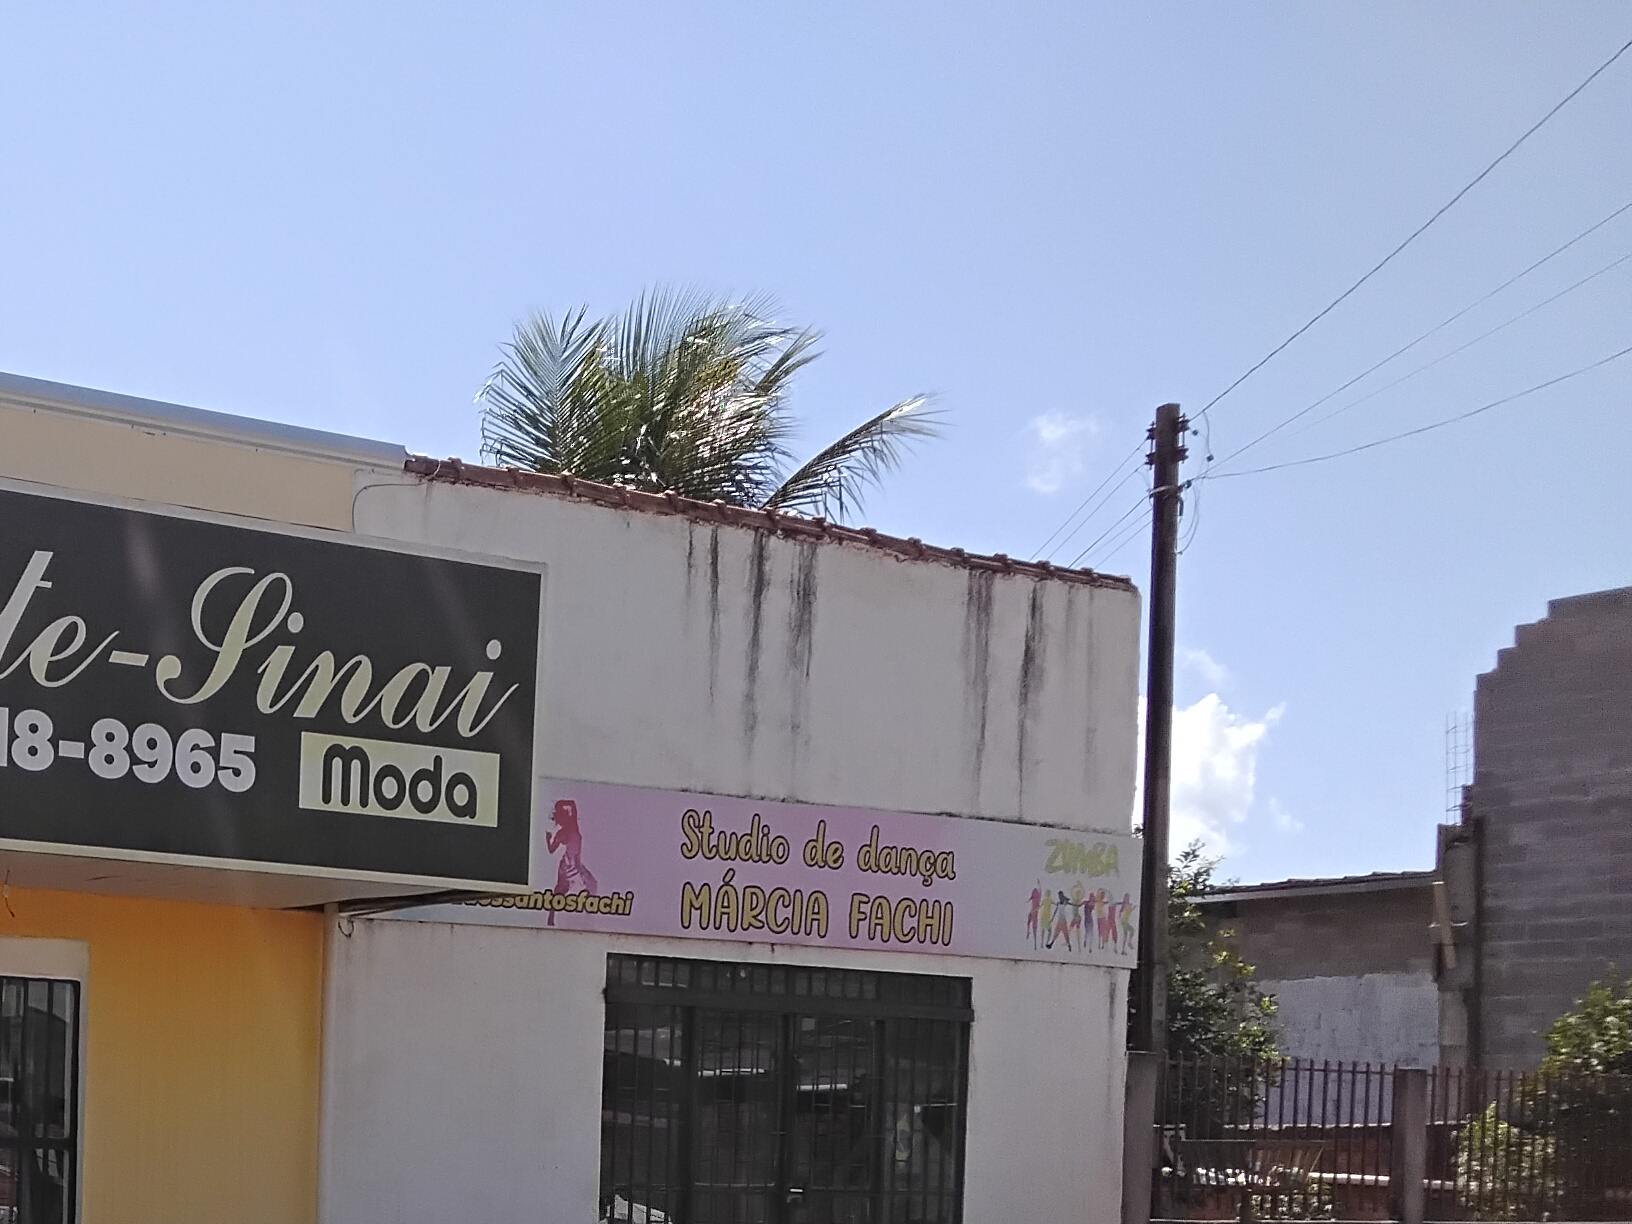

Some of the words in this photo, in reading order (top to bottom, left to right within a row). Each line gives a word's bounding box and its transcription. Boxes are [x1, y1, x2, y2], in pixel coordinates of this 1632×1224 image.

[321, 742, 478, 820] Moda
[680, 808, 790, 865] Studio
[803, 819, 845, 870] de
[857, 825, 956, 887] dança
[680, 867, 829, 938] MÁRCIA
[848, 892, 954, 946] FACHI
